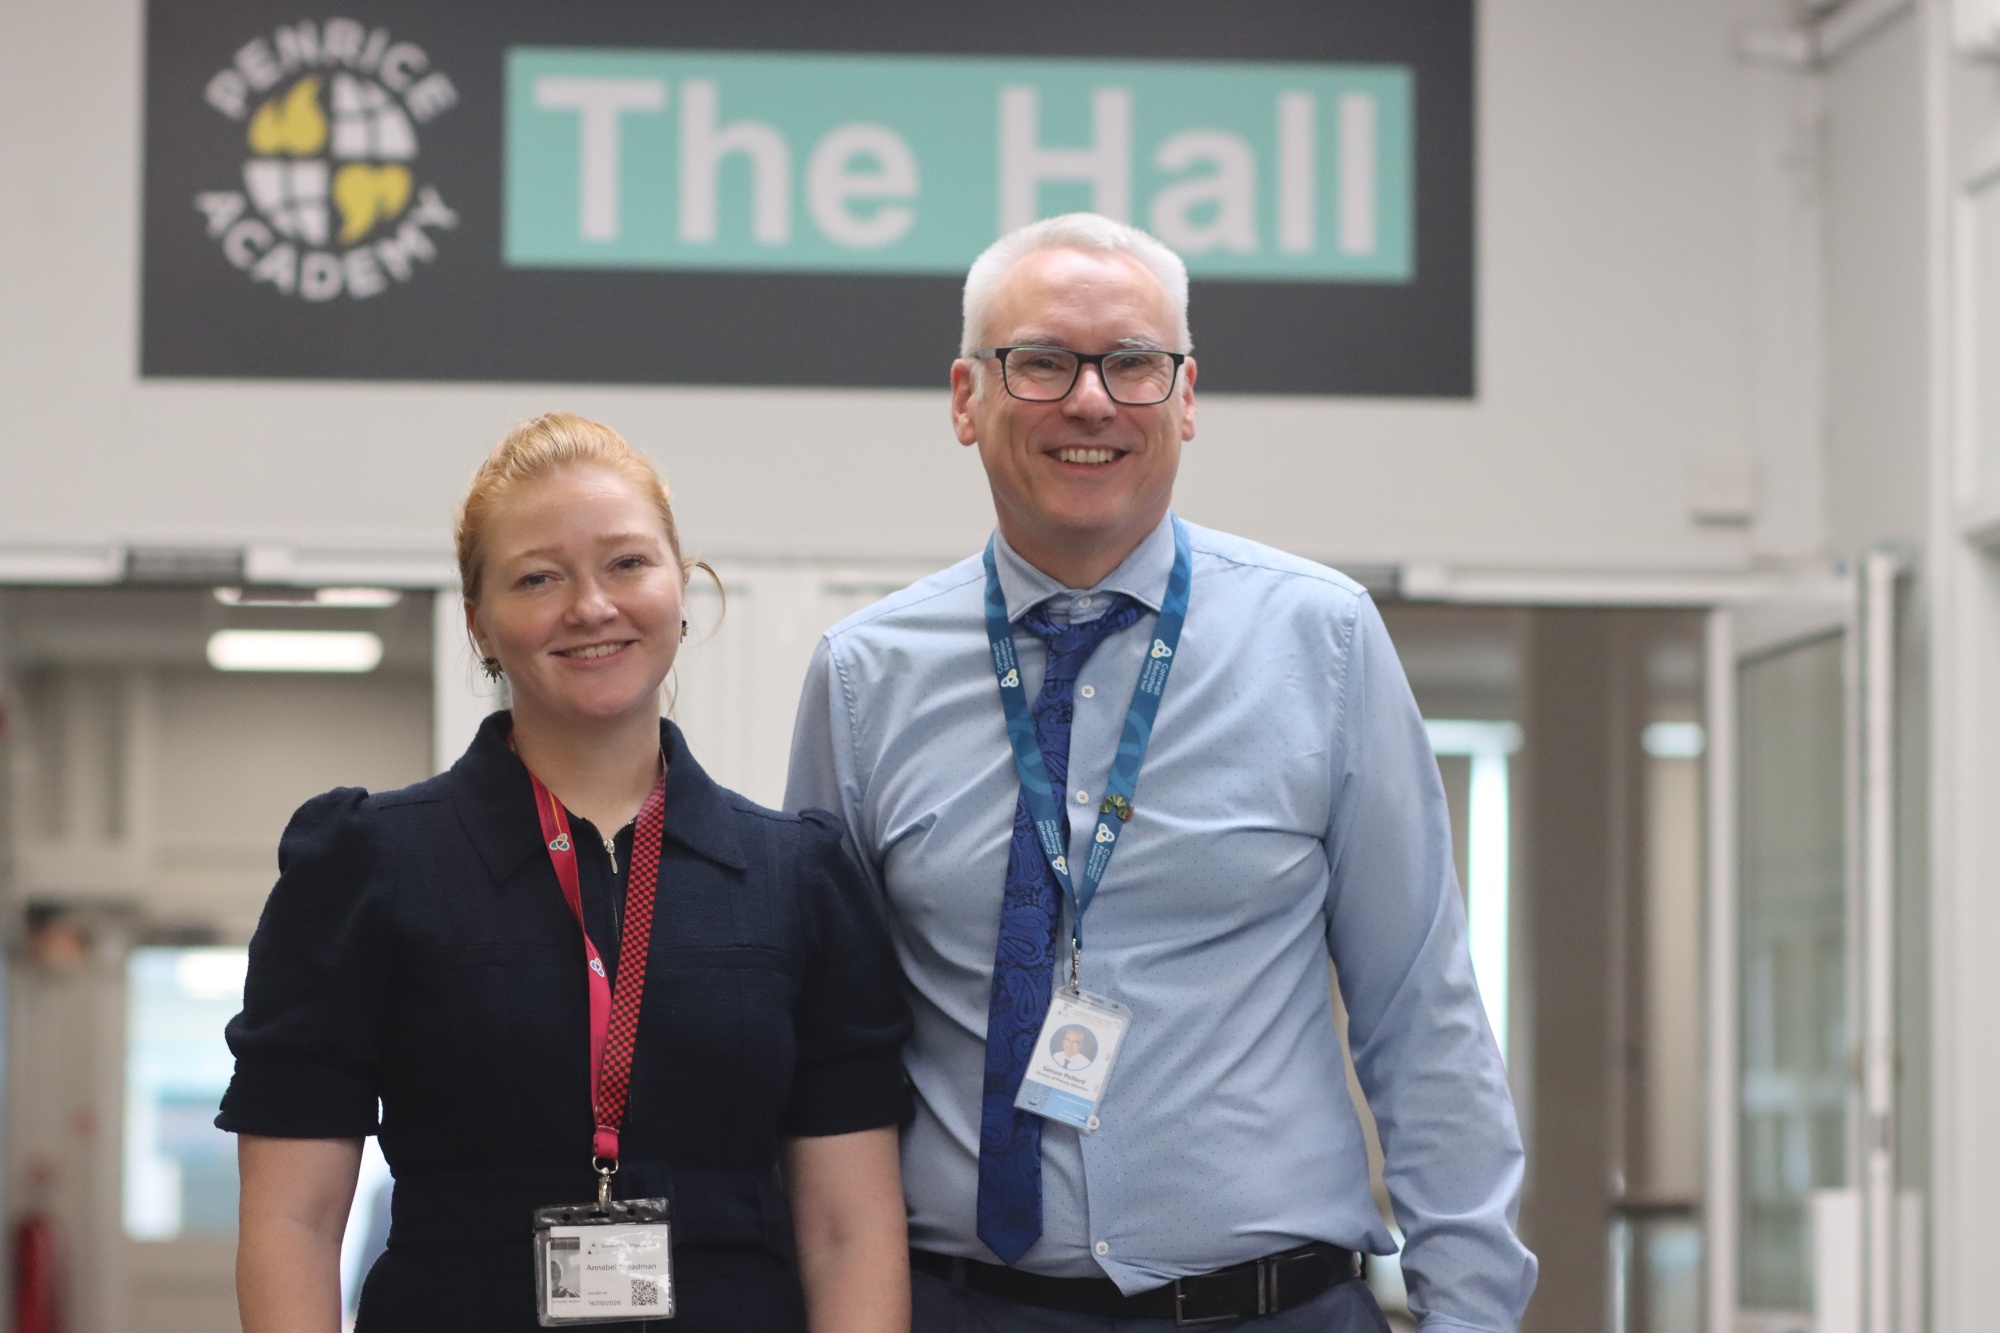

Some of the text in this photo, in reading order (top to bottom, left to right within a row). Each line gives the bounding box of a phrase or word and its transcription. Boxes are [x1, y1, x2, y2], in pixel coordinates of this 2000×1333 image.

[205, 16, 457, 123] PENRICE
[534, 76, 1377, 257] The Hall
[195, 187, 458, 301] ACADEMY
[1146, 660, 1162, 693] Education
[1153, 663, 1169, 696] Cornwall
[1037, 820, 1052, 854] Cornwall
[1045, 820, 1058, 854] Education
[1090, 845, 1104, 879] Education
[1094, 848, 1110, 883] Cornwall
[1041, 1065, 1086, 1085] Simon Pollard
